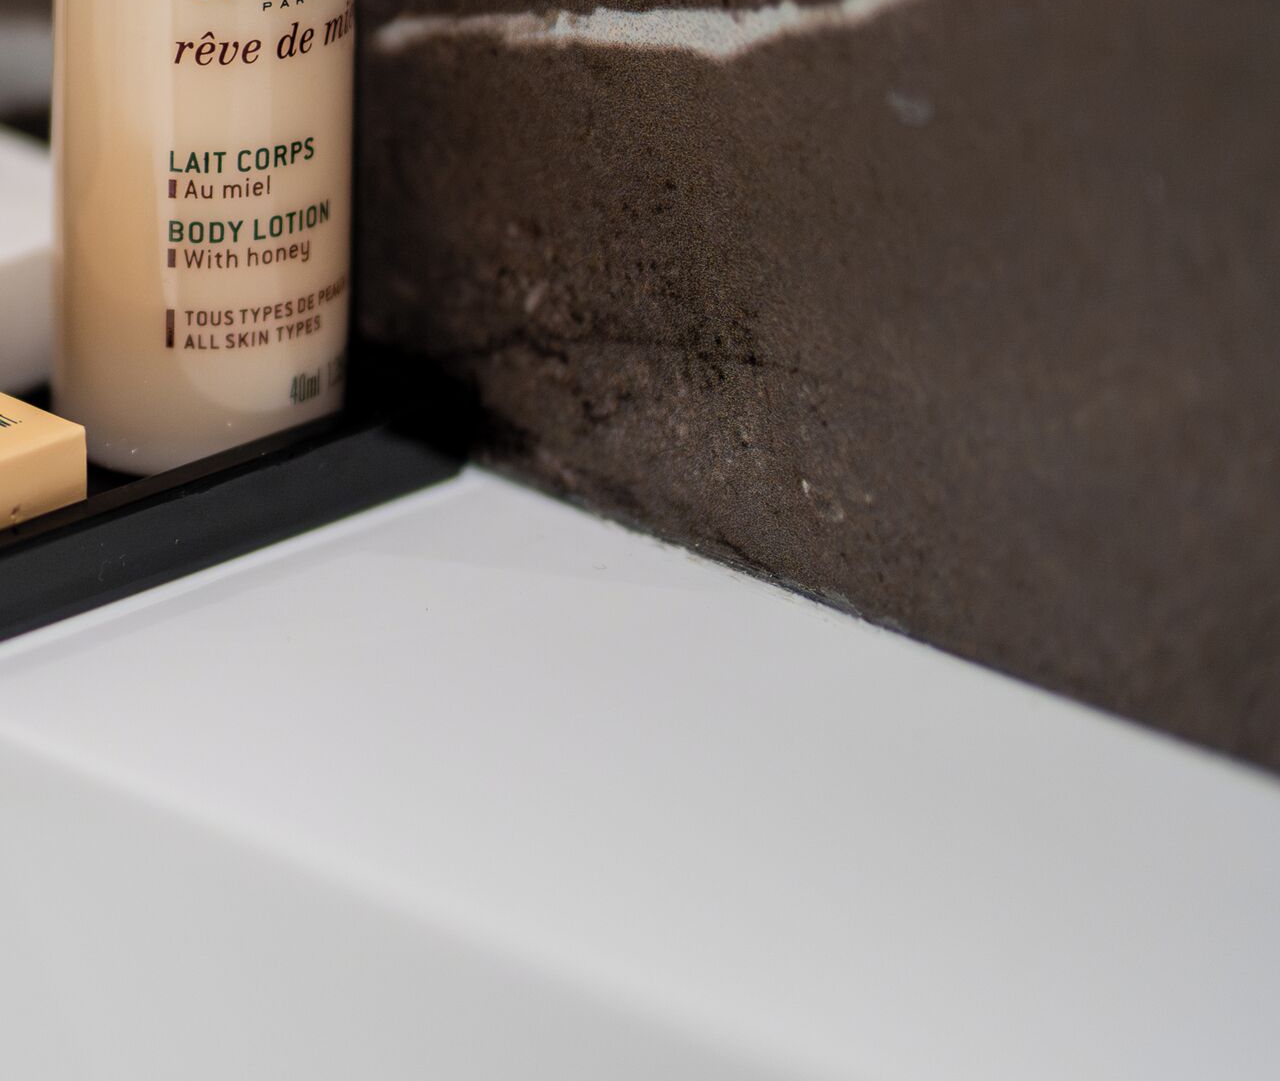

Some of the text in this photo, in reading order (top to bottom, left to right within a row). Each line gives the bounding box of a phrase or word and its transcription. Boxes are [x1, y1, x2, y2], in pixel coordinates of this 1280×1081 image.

[173, 31, 261, 66] rêve
[276, 21, 314, 58] de
[169, 136, 315, 173] LAIT CORPS
[184, 175, 271, 199] Au miel
[168, 199, 331, 244] BODY LOTION
[184, 240, 312, 269] With honey
[184, 309, 234, 327] TOUS
[240, 301, 293, 325] TYPES
[298, 294, 315, 314] DE
[184, 315, 322, 350] ALL SKIN TYPES
